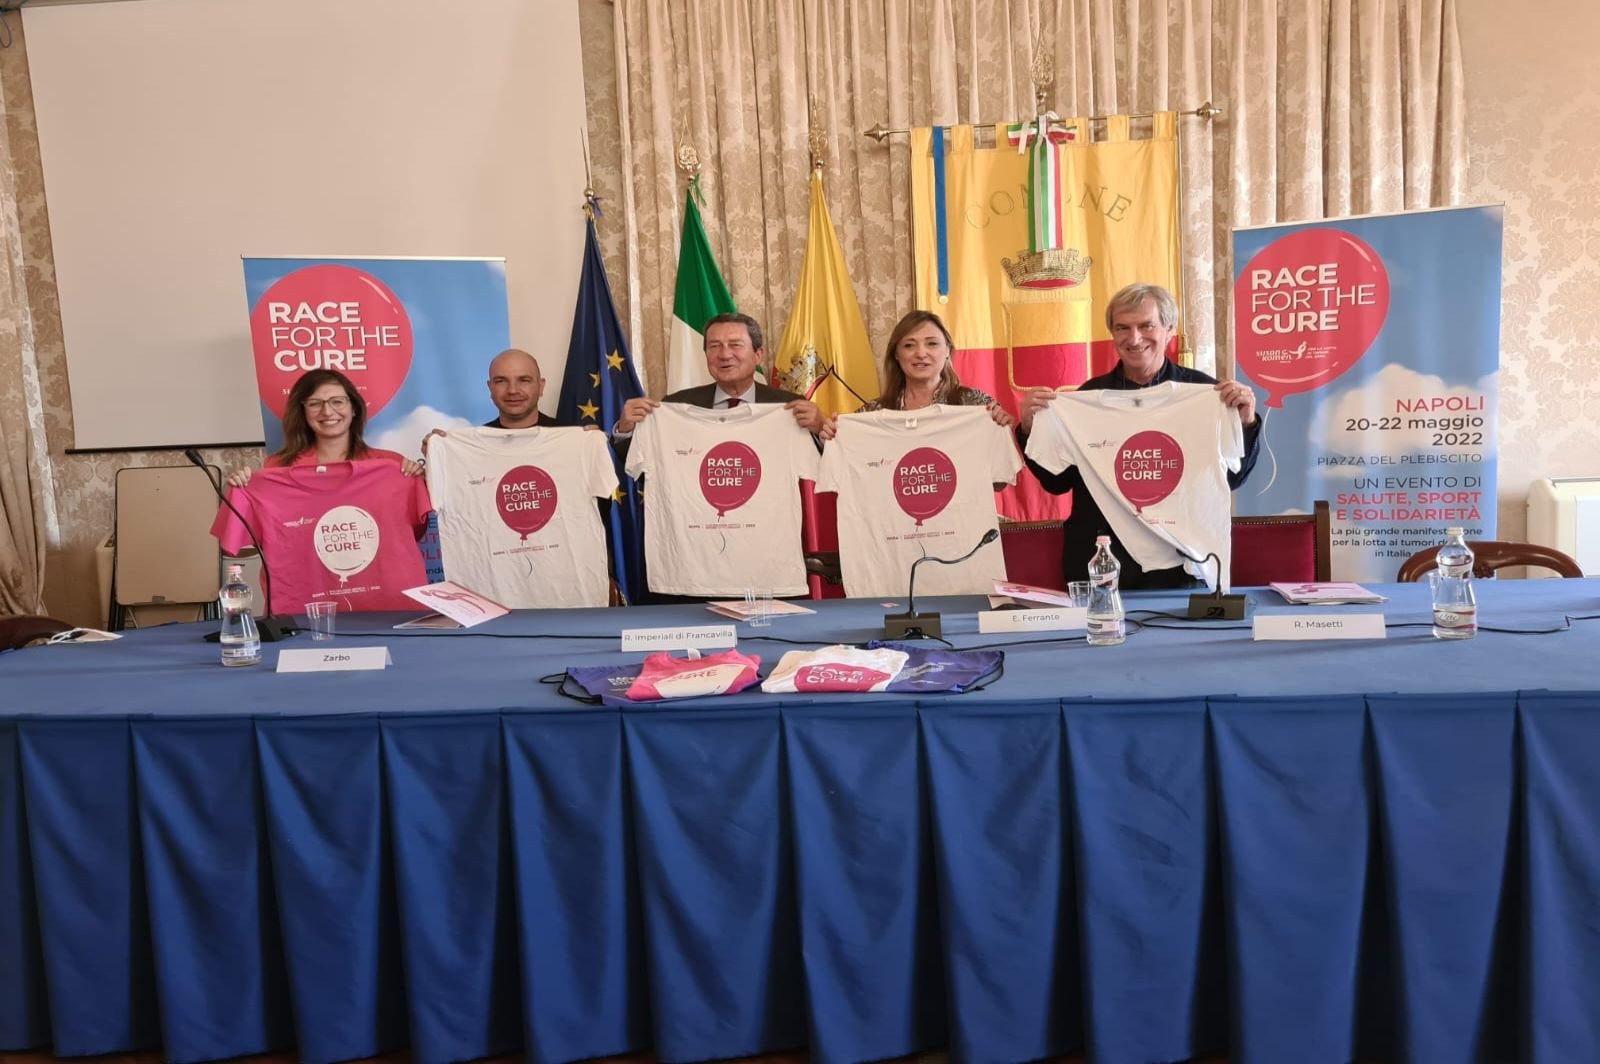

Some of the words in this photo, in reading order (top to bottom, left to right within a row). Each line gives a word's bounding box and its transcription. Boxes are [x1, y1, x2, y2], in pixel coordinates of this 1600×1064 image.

[966, 182, 1132, 230] CONE
[1251, 262, 1338, 290] RACE
[1252, 289, 1312, 313] FOR
[1317, 284, 1376, 310] THE
[268, 302, 361, 324] RACE
[1251, 310, 1340, 336] CURE
[271, 326, 337, 348] FOR
[340, 326, 401, 346] THE
[274, 348, 368, 372] CURE
[1396, 396, 1484, 413] NAPOLI
[1346, 416, 1402, 431] 20-22
[1408, 414, 1484, 430] maggio
[1432, 432, 1483, 446] 2022
[1122, 449, 1162, 460] RACE
[1318, 456, 1366, 466] PIAZZA
[1370, 455, 1396, 465] DEL
[1400, 454, 1482, 464] PLEBISCITO
[707, 458, 742, 467] RACE
[1122, 460, 1150, 470] FOR
[1152, 459, 1178, 469] THE
[707, 468, 732, 476] FOR
[734, 468, 756, 476] THE
[900, 464, 936, 476] RACE
[1122, 470, 1162, 480] CURE
[707, 478, 742, 486] CURE
[901, 476, 926, 487] FOR
[928, 472, 952, 482] THE
[1354, 477, 1379, 490] UN
[1385, 476, 1458, 489] EVENTO
[1464, 476, 1481, 488] DI
[502, 481, 537, 493] RACE
[902, 484, 938, 496] CURE
[504, 492, 528, 502] FOR
[530, 489, 552, 500] THE
[1336, 492, 1412, 506] SALUTE,
[1417, 492, 1482, 504] SPORT
[506, 500, 540, 512] CURE
[1336, 509, 1347, 520] E
[1352, 506, 1481, 520] SOLIDARIETÀ
[321, 522, 358, 534] RACE
[1345, 527, 1361, 538] più
[1364, 528, 1400, 538] grande
[1402, 527, 1483, 536] manifestone
[323, 533, 348, 543] FOR
[352, 530, 375, 540] THE
[324, 542, 361, 552] CURE
[1332, 540, 1350, 549] per
[1386, 550, 1412, 558] Italia
[1022, 614, 1060, 622] Ferrante
[1294, 620, 1304, 629] R.
[1306, 620, 1344, 628] Masetti
[676, 632, 684, 640] di
[687, 630, 733, 639] Francavilla
[323, 654, 351, 662] Zarbo
